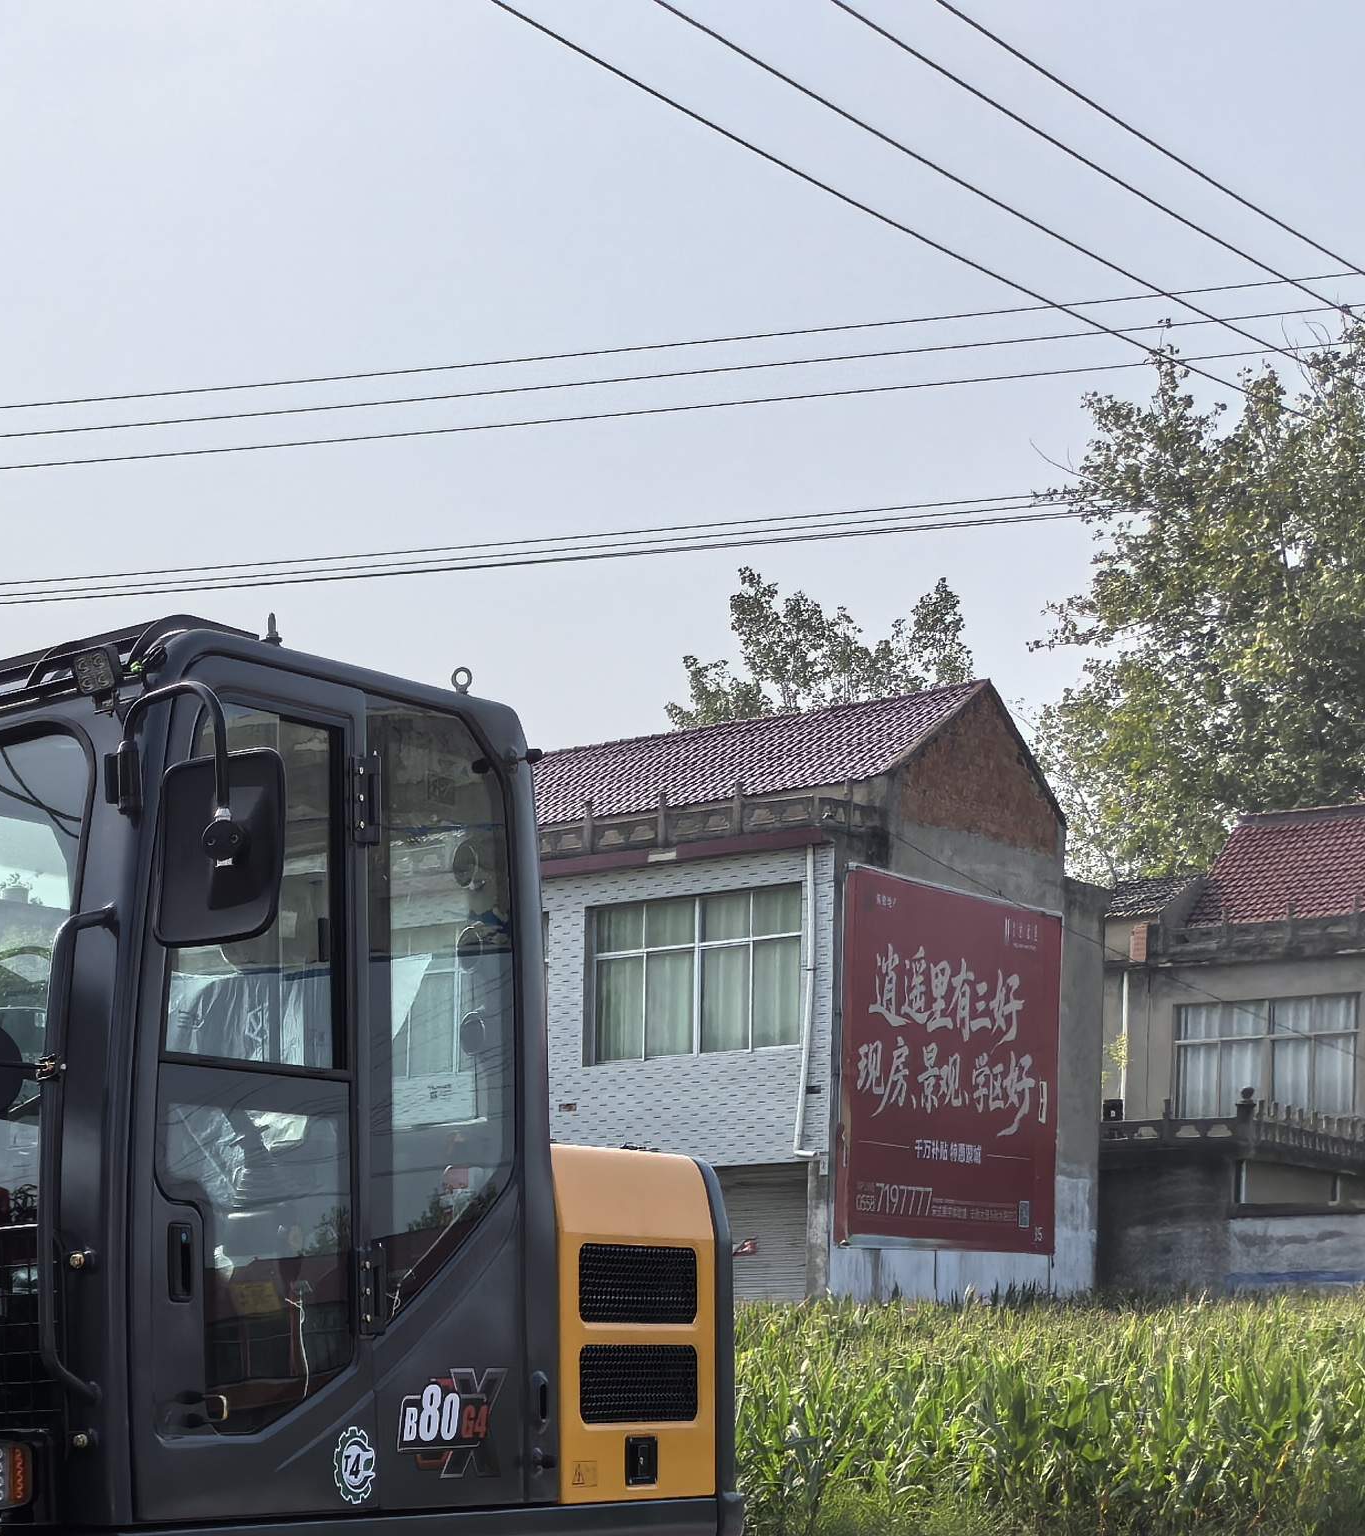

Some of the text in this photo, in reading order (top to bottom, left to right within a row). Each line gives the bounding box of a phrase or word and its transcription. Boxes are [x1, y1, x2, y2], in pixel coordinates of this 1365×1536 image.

[869, 944, 1025, 1053] 逍遥里有三好
